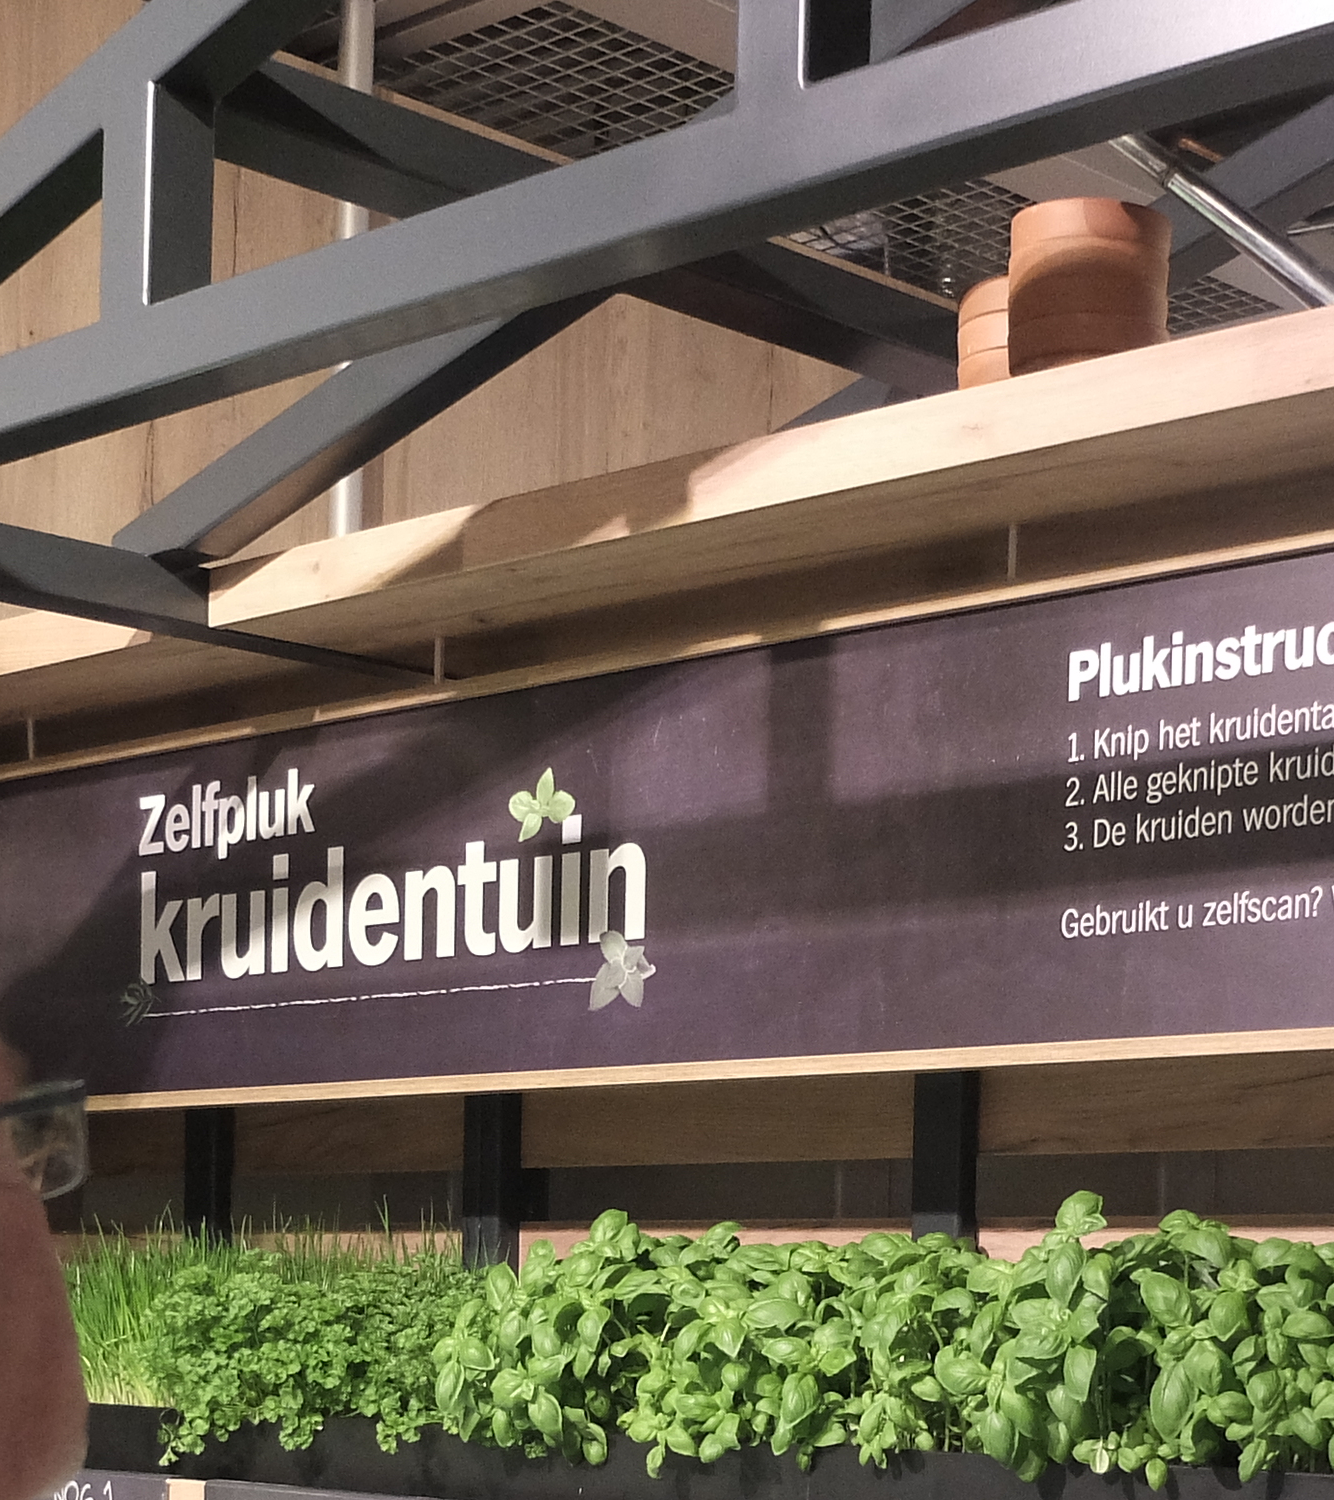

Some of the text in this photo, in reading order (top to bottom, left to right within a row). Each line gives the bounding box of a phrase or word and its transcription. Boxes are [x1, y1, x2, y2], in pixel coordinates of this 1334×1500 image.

[1067, 731, 1085, 762] 1.
[1093, 725, 1150, 760] Knip
[1159, 717, 1201, 750] het
[1065, 777, 1085, 807] 2.
[1093, 771, 1138, 804] Alle
[1146, 758, 1259, 804] geknipte
[138, 768, 315, 860] Zelfpluk
[1063, 822, 1085, 851] 3.
[1093, 819, 1126, 848] De
[1136, 806, 1233, 844] kruiden
[140, 814, 647, 985] kruidentuin
[1061, 901, 1169, 938] Gebruikt
[1177, 903, 1194, 929] u
[1202, 886, 1324, 927] zelfscan?
